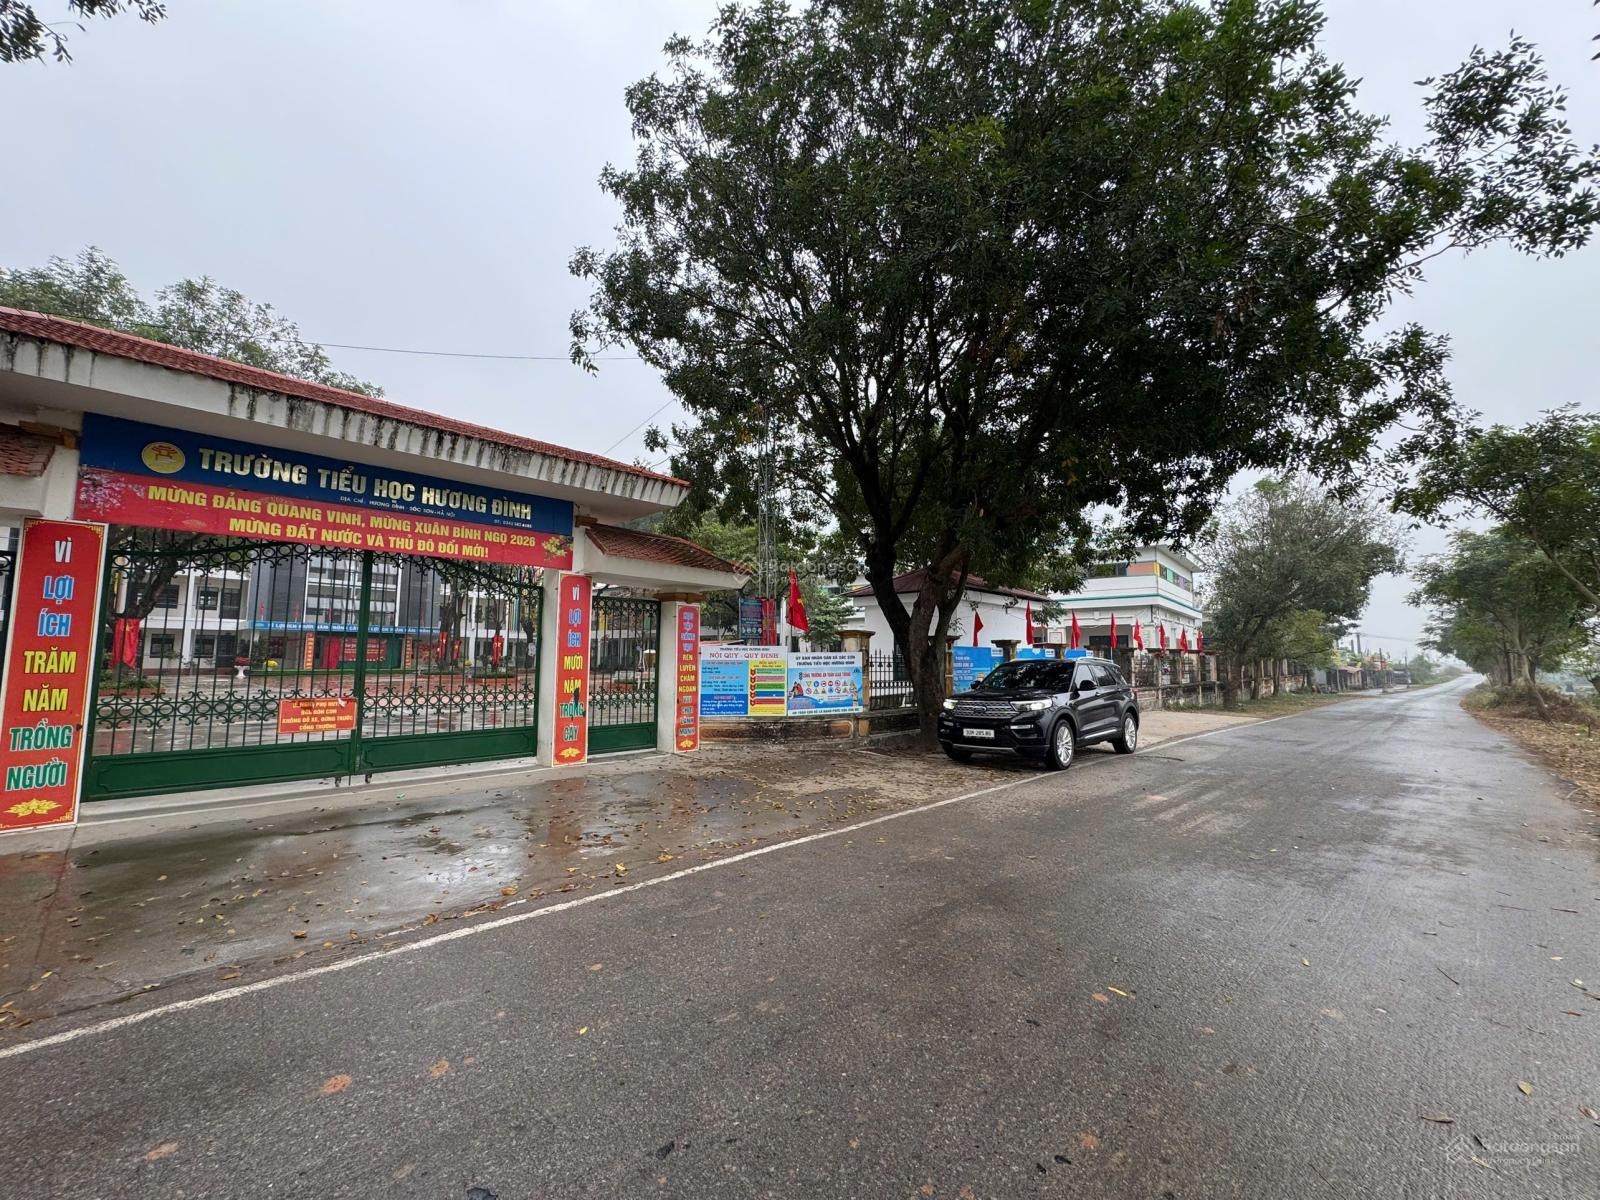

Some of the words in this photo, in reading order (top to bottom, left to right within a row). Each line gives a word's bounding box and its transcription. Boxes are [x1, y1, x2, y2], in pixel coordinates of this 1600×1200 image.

[199, 448, 308, 485] TRƯỜNG
[318, 466, 367, 494] TIỂU
[373, 479, 416, 504] HỌC
[422, 486, 487, 513] HƯƠNG
[491, 496, 532, 520] ĐÌNH
[148, 484, 207, 506] MỪNG
[212, 491, 262, 513] ĐẢNG
[266, 502, 322, 521] QUANG
[326, 510, 366, 528] VINH,
[369, 515, 411, 532] MỪNG
[415, 521, 450, 537] XUÂN
[453, 525, 481, 541] BÍNH
[484, 531, 508, 546] NGỌ
[510, 534, 536, 547] 2026
[54, 538, 72, 563] VÌ
[229, 517, 282, 536] MỪNG
[286, 522, 317, 540] ĐẤT
[321, 528, 362, 545] NƯỚC
[366, 533, 385, 547] VÀ
[389, 534, 414, 551] THỦ
[417, 539, 435, 553] ĐÔ
[438, 540, 459, 555] ĐỔI
[462, 544, 489, 558] MỚI!
[43, 575, 74, 604] LỢI
[572, 584, 580, 601] VÌ
[37, 608, 71, 637] ÍCH
[569, 608, 582, 628] LỢI
[567, 629, 582, 648] ÍCH
[23, 646, 77, 674] TRĂM
[563, 652, 583, 671] MƯỜI
[22, 684, 68, 712] NĂM
[563, 676, 582, 694] NĂM
[9, 719, 72, 752] TRỒNG
[6, 758, 68, 791] NGƯỜI
